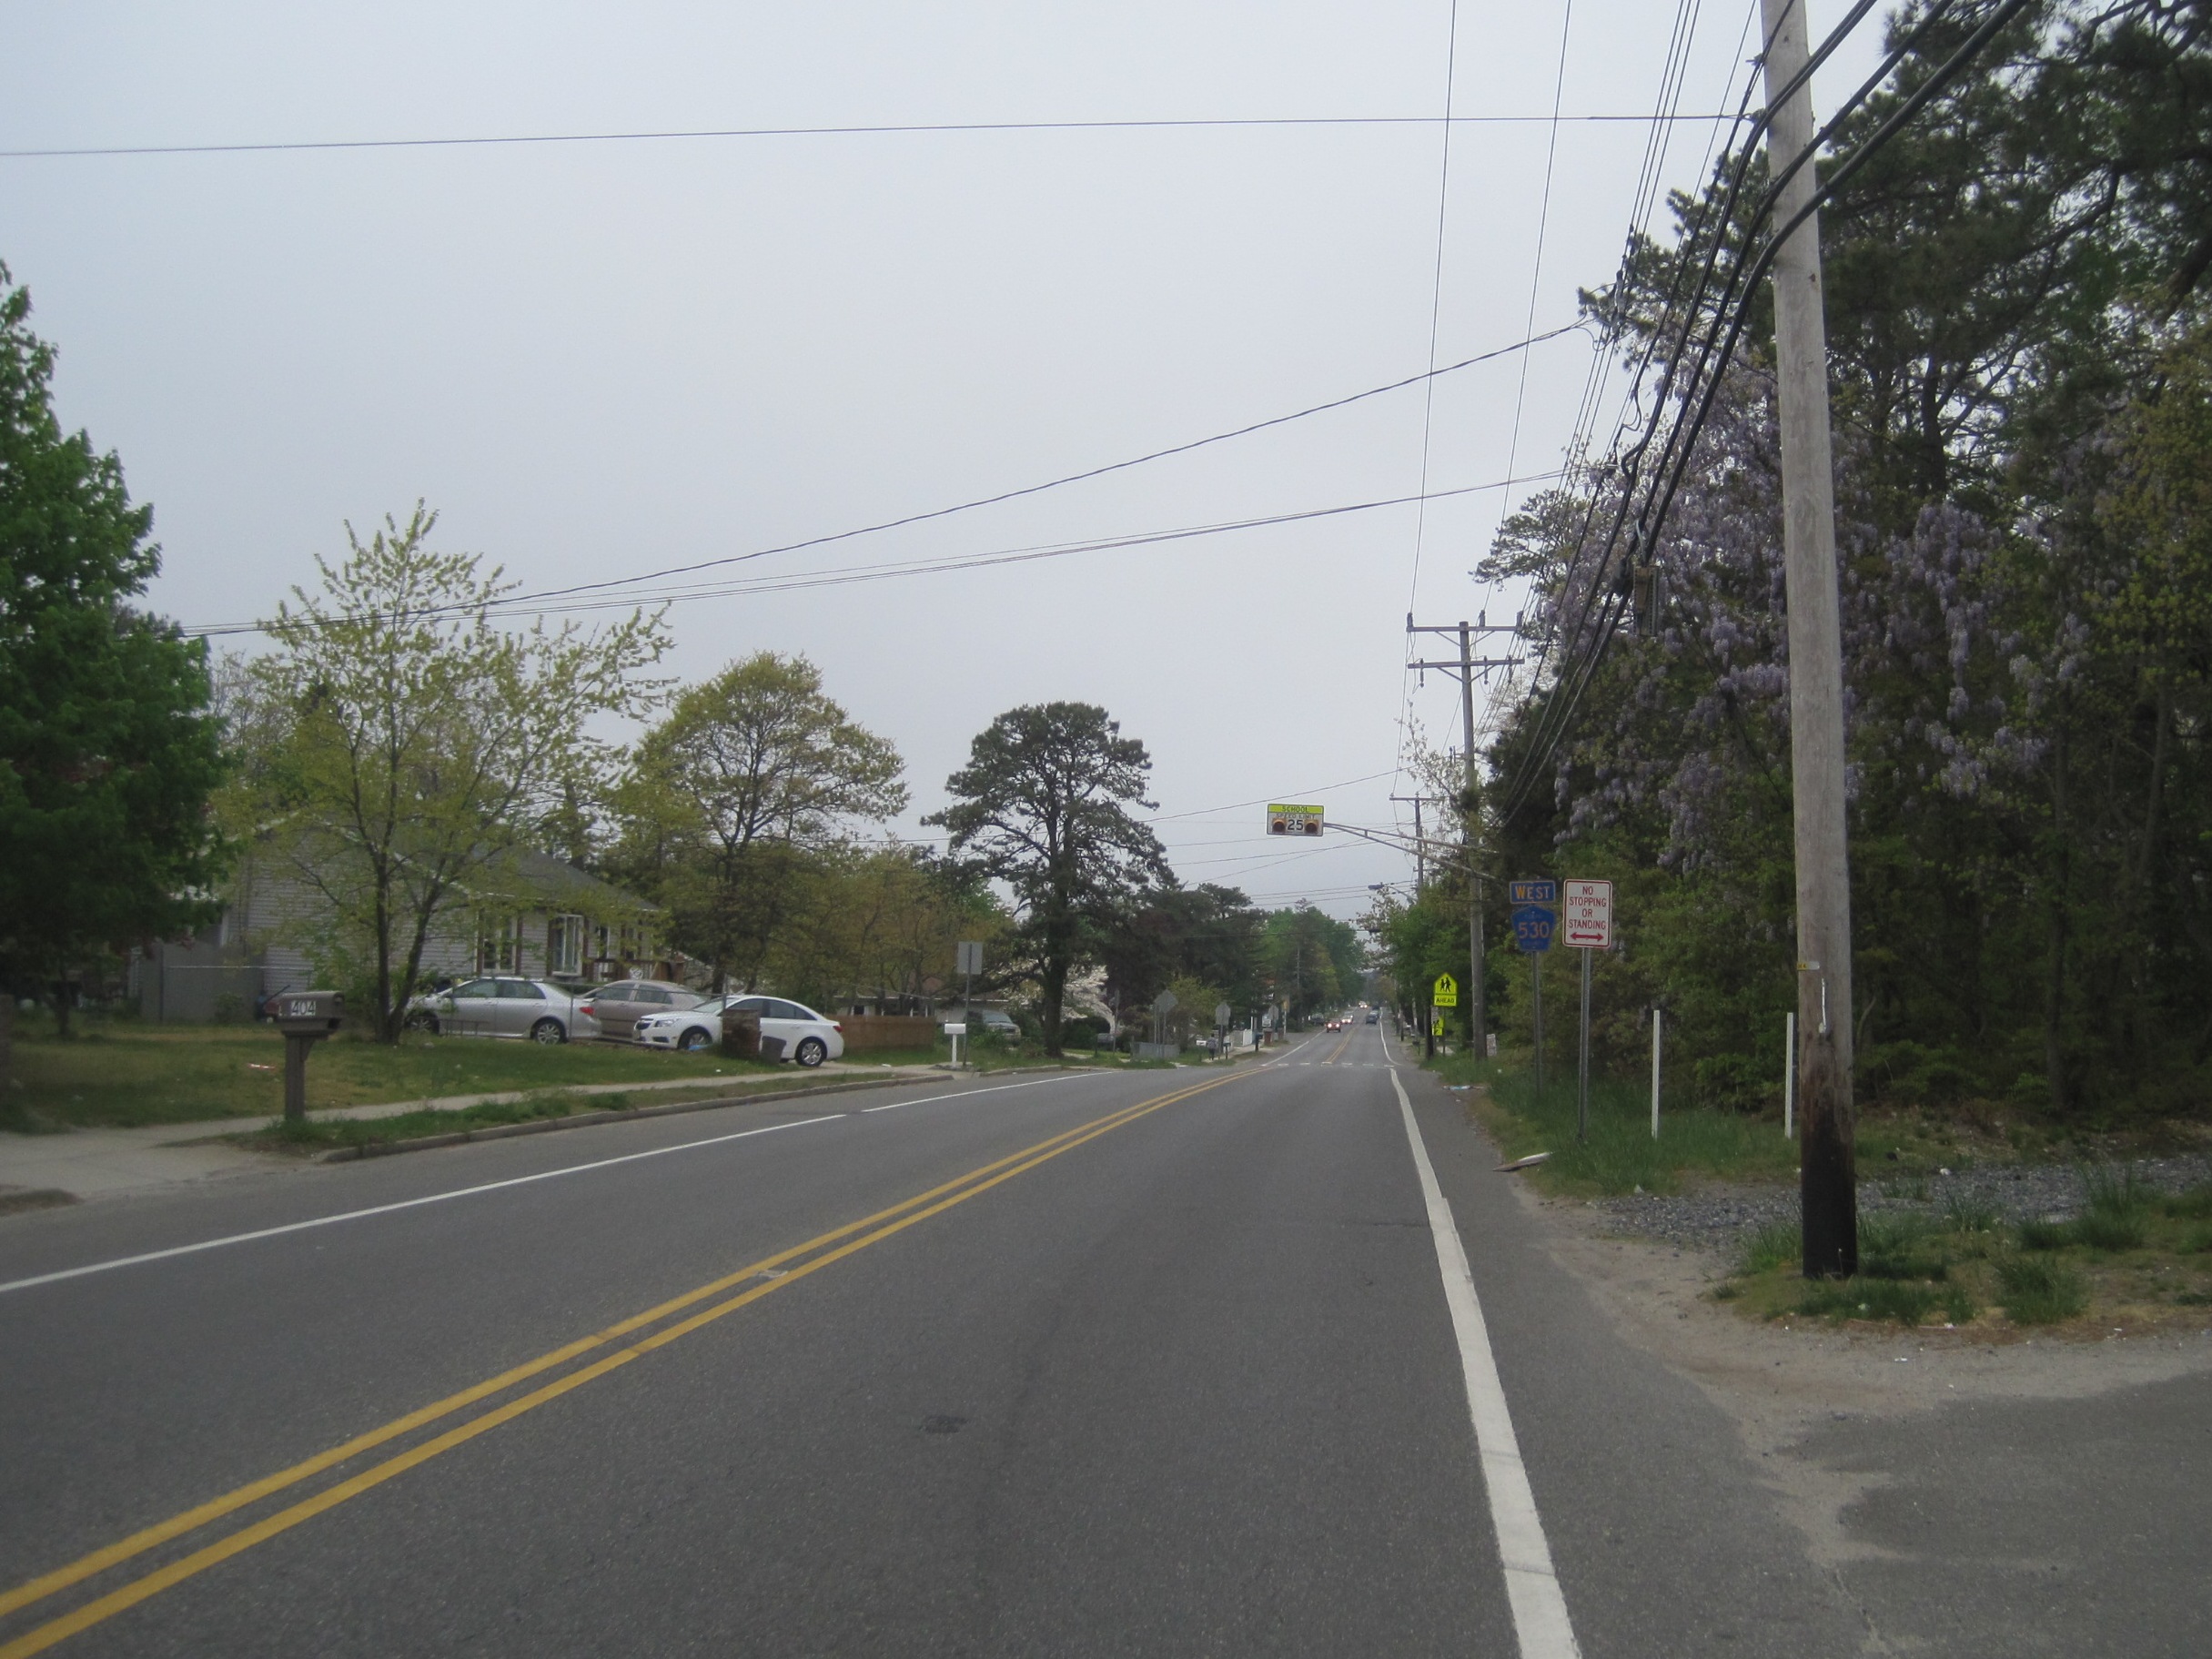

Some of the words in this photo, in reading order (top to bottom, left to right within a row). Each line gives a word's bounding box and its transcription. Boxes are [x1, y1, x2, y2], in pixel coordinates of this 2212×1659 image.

[1288, 819, 1304, 830] 25
[1515, 885, 1550, 900] WEST
[1582, 886, 1593, 895] NO
[1569, 896, 1607, 907] STOPPING
[1581, 909, 1593, 917] OR
[1569, 919, 1606, 930] STANDING
[1519, 922, 1550, 939] 530
[292, 1000, 315, 1016] 404
